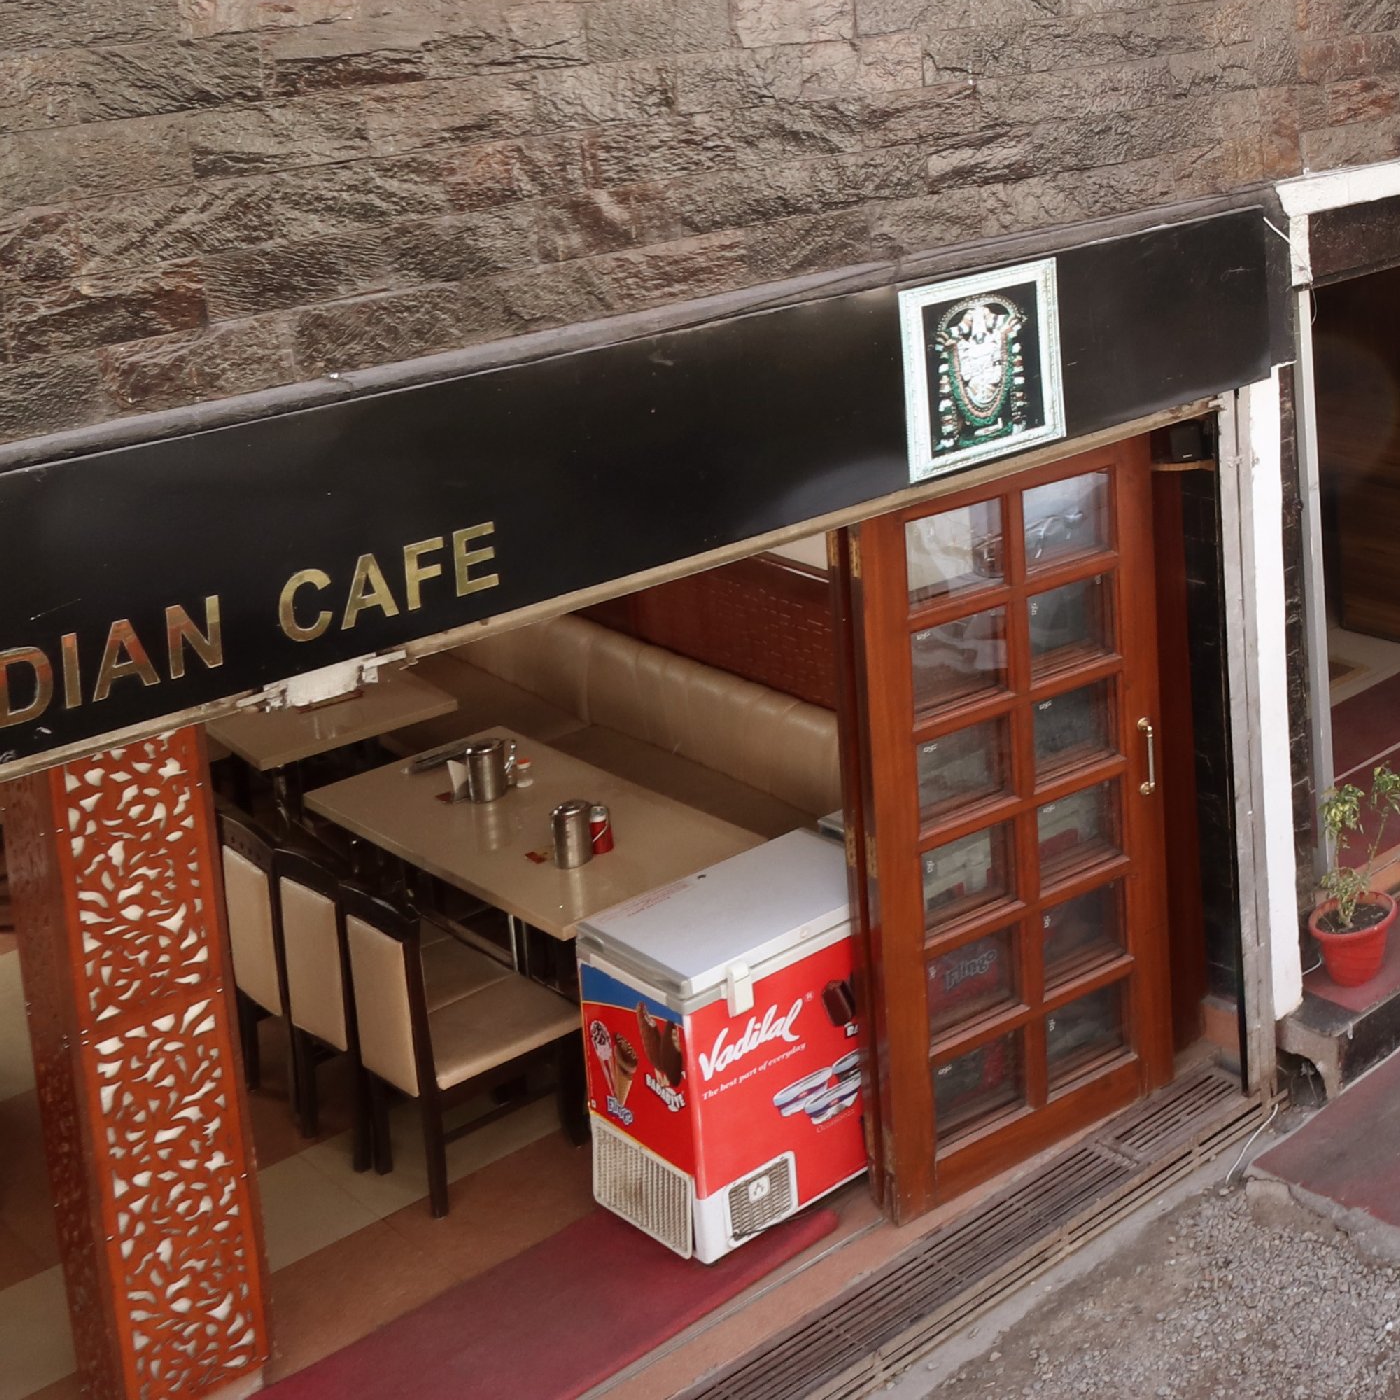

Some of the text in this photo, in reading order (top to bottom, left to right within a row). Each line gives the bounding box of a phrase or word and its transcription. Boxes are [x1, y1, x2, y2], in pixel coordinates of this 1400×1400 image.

[279, 521, 499, 643] CAFE
[698, 998, 803, 1081] Vadilal
[703, 1042, 806, 1100] The best part of everyday
